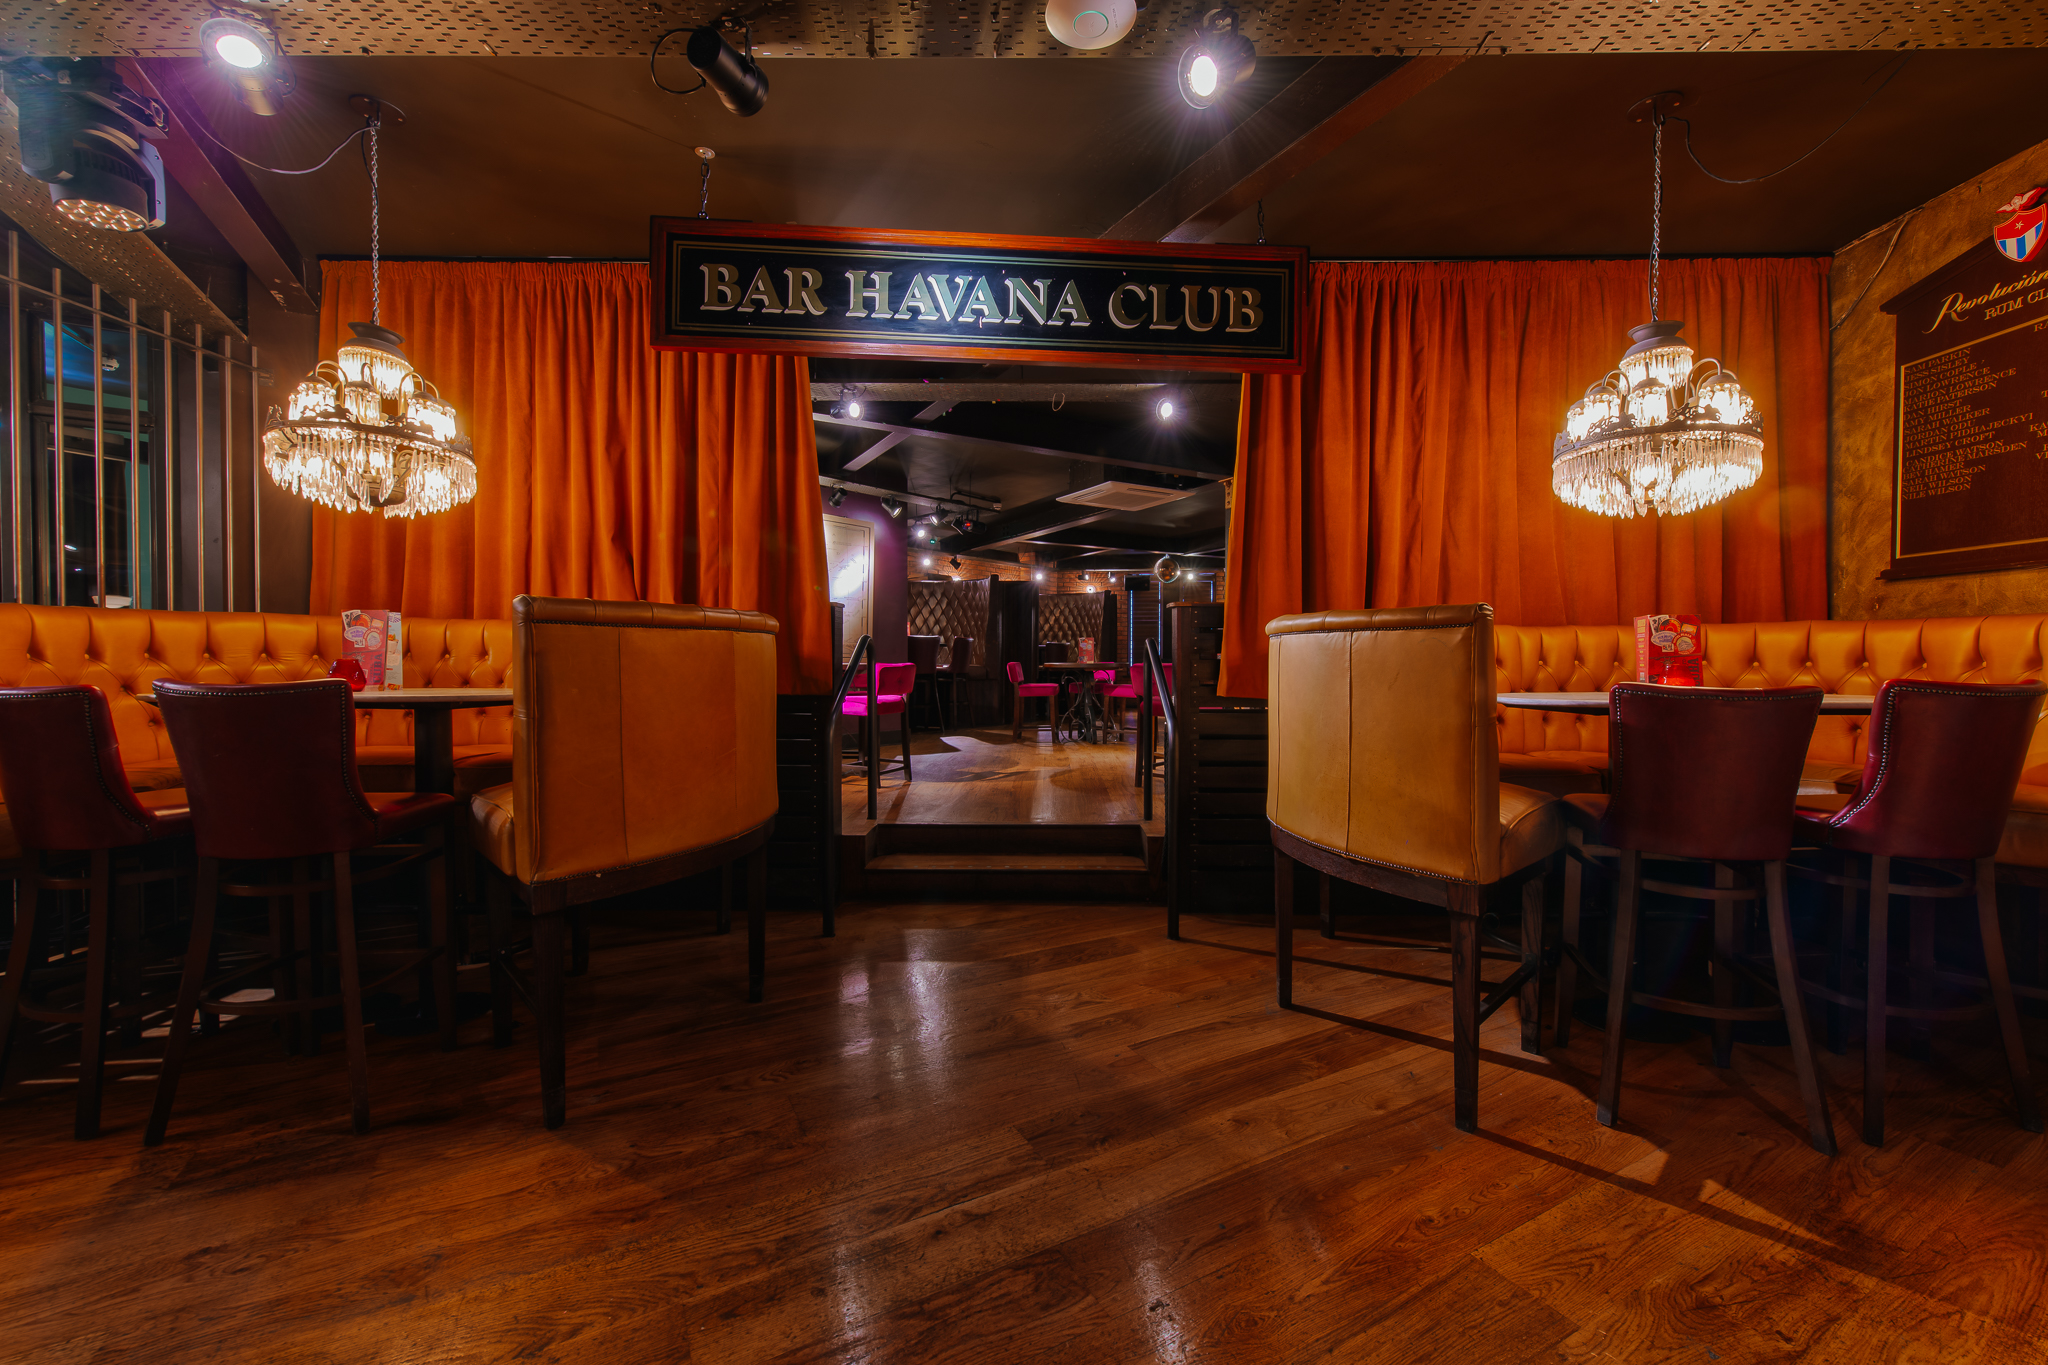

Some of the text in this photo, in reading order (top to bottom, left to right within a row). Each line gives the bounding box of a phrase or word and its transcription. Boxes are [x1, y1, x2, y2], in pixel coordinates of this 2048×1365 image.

[700, 262, 1264, 333] BAR HAVANA CLUB
[1984, 296, 2024, 320] RUM
[1904, 348, 1971, 374] SAM PARKIN
[1904, 357, 1970, 382] JESS SISLEY
[1904, 366, 1990, 397] JON LOWRENCE
[1904, 376, 1938, 390] SIMON
[1904, 368, 2016, 405] MARION LOWRENCE
[1904, 380, 1998, 412] KATIE PATERSON
[1904, 399, 1962, 421] DAN HIRST
[1904, 405, 1971, 428] AMY MILLER
[1904, 407, 1990, 436] SARAH WALKER
[1904, 419, 1976, 442] JORDAN ODU
[1905, 434, 1948, 450] MARTIN
[1903, 455, 1965, 473] CATHERINE
[1966, 441, 2028, 461] MARSDEN
[1906, 431, 1996, 458] LINDSEY CROFT
[1906, 439, 2004, 466] CANDICE WATSON
[1902, 465, 1986, 486] SARAH WATSON
[1902, 474, 1972, 493] NEIL WILSON
[1903, 462, 1964, 480] BEV HAMER
[1902, 483, 1971, 500] NILE WILSON
[373, 653, 382, 683] CUBA
